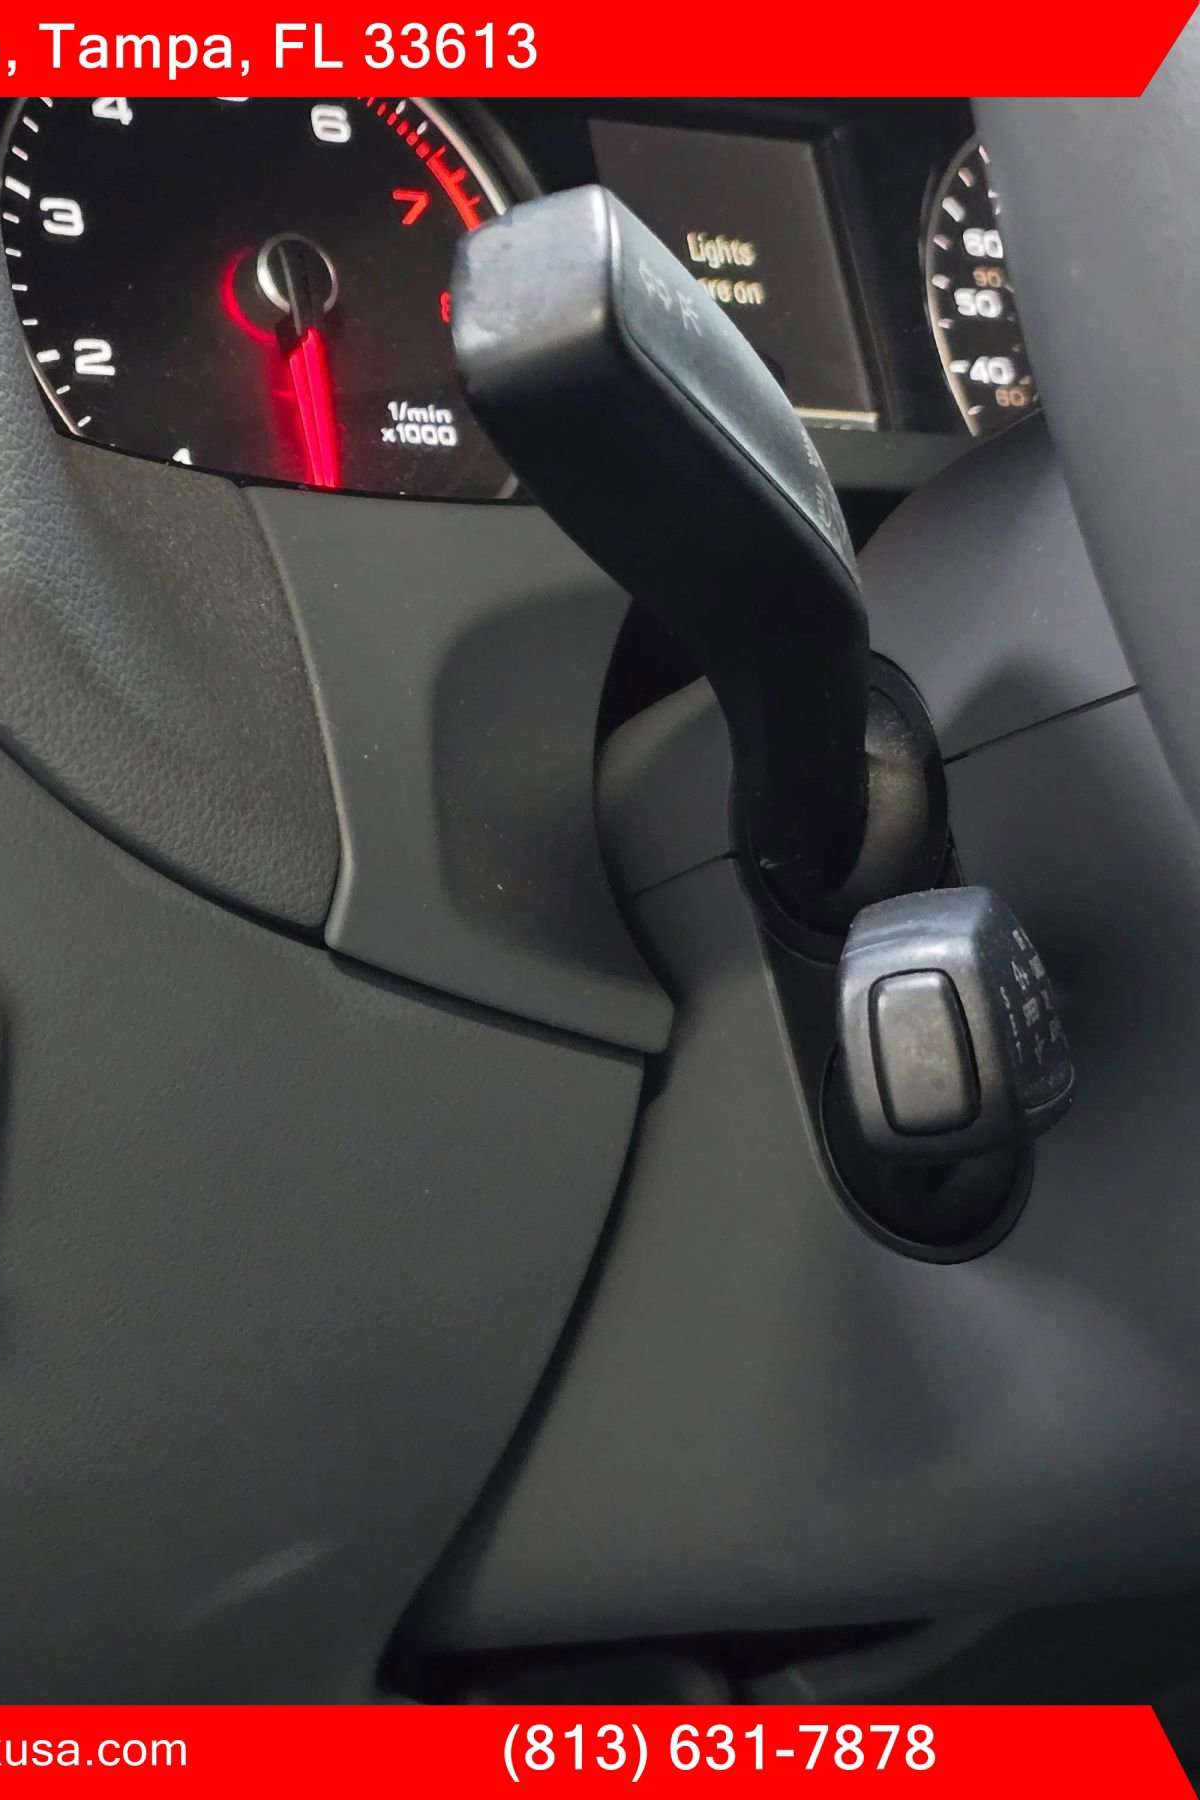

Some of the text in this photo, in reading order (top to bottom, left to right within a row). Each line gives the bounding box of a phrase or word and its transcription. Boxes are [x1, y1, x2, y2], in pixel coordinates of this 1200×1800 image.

[310, 104, 352, 143] 6
[39, 198, 85, 237] 3
[392, 188, 430, 225] 7
[687, 232, 756, 269] Lights
[697, 278, 765, 305] re on
[953, 287, 1003, 318] 50
[73, 338, 116, 376] 2
[969, 356, 1016, 385] 40
[386, 400, 454, 424] 1/min
[379, 422, 458, 448] x1000
